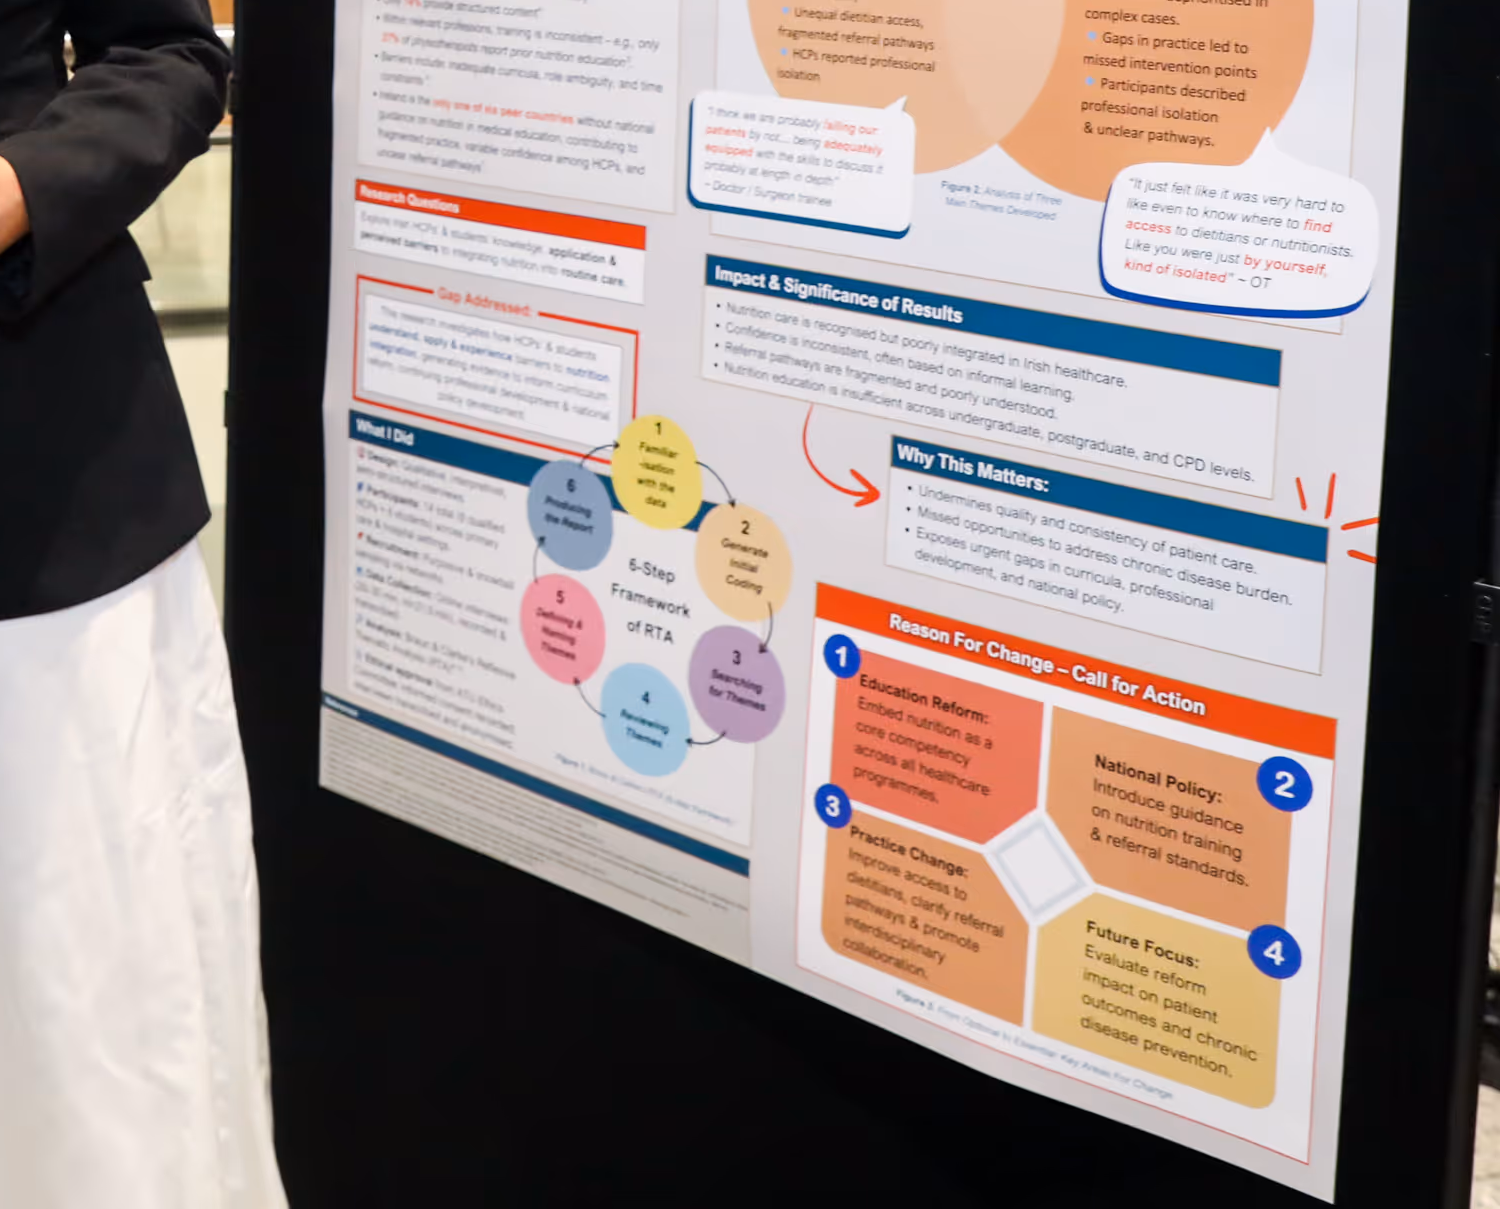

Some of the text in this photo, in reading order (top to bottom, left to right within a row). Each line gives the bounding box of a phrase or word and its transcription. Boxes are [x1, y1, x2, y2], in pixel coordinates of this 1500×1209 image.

[1084, 9, 1180, 25] complex cases.
[714, 264, 964, 325] Impact & Significance of Results
[654, 421, 662, 435] 1
[897, 443, 1050, 492] Why This Matters:
[566, 477, 576, 493] 6
[740, 519, 750, 535] 2
[628, 557, 676, 585] 6-Step
[555, 589, 565, 604] 5
[611, 582, 690, 618] Framework
[626, 620, 673, 644] of RTA
[731, 649, 741, 666] 3
[834, 645, 847, 667] 1
[889, 612, 950, 644] Reason
[953, 630, 984, 652] For
[986, 640, 1054, 674] Change
[1071, 664, 1108, 688] Call
[1111, 675, 1139, 696] for
[1141, 684, 1206, 715] Action
[641, 691, 651, 706] 4
[859, 674, 990, 724] Education Reform:
[1092, 754, 1222, 804] National Policy:
[1273, 770, 1295, 798] 2
[824, 794, 840, 817] 3
[1093, 777, 1244, 835] Introduce guidance
[1090, 805, 1242, 862] on nutrition training
[849, 824, 969, 878] Practice Change:
[1086, 919, 1198, 969] Future Focus:
[1262, 940, 1285, 966] 4
